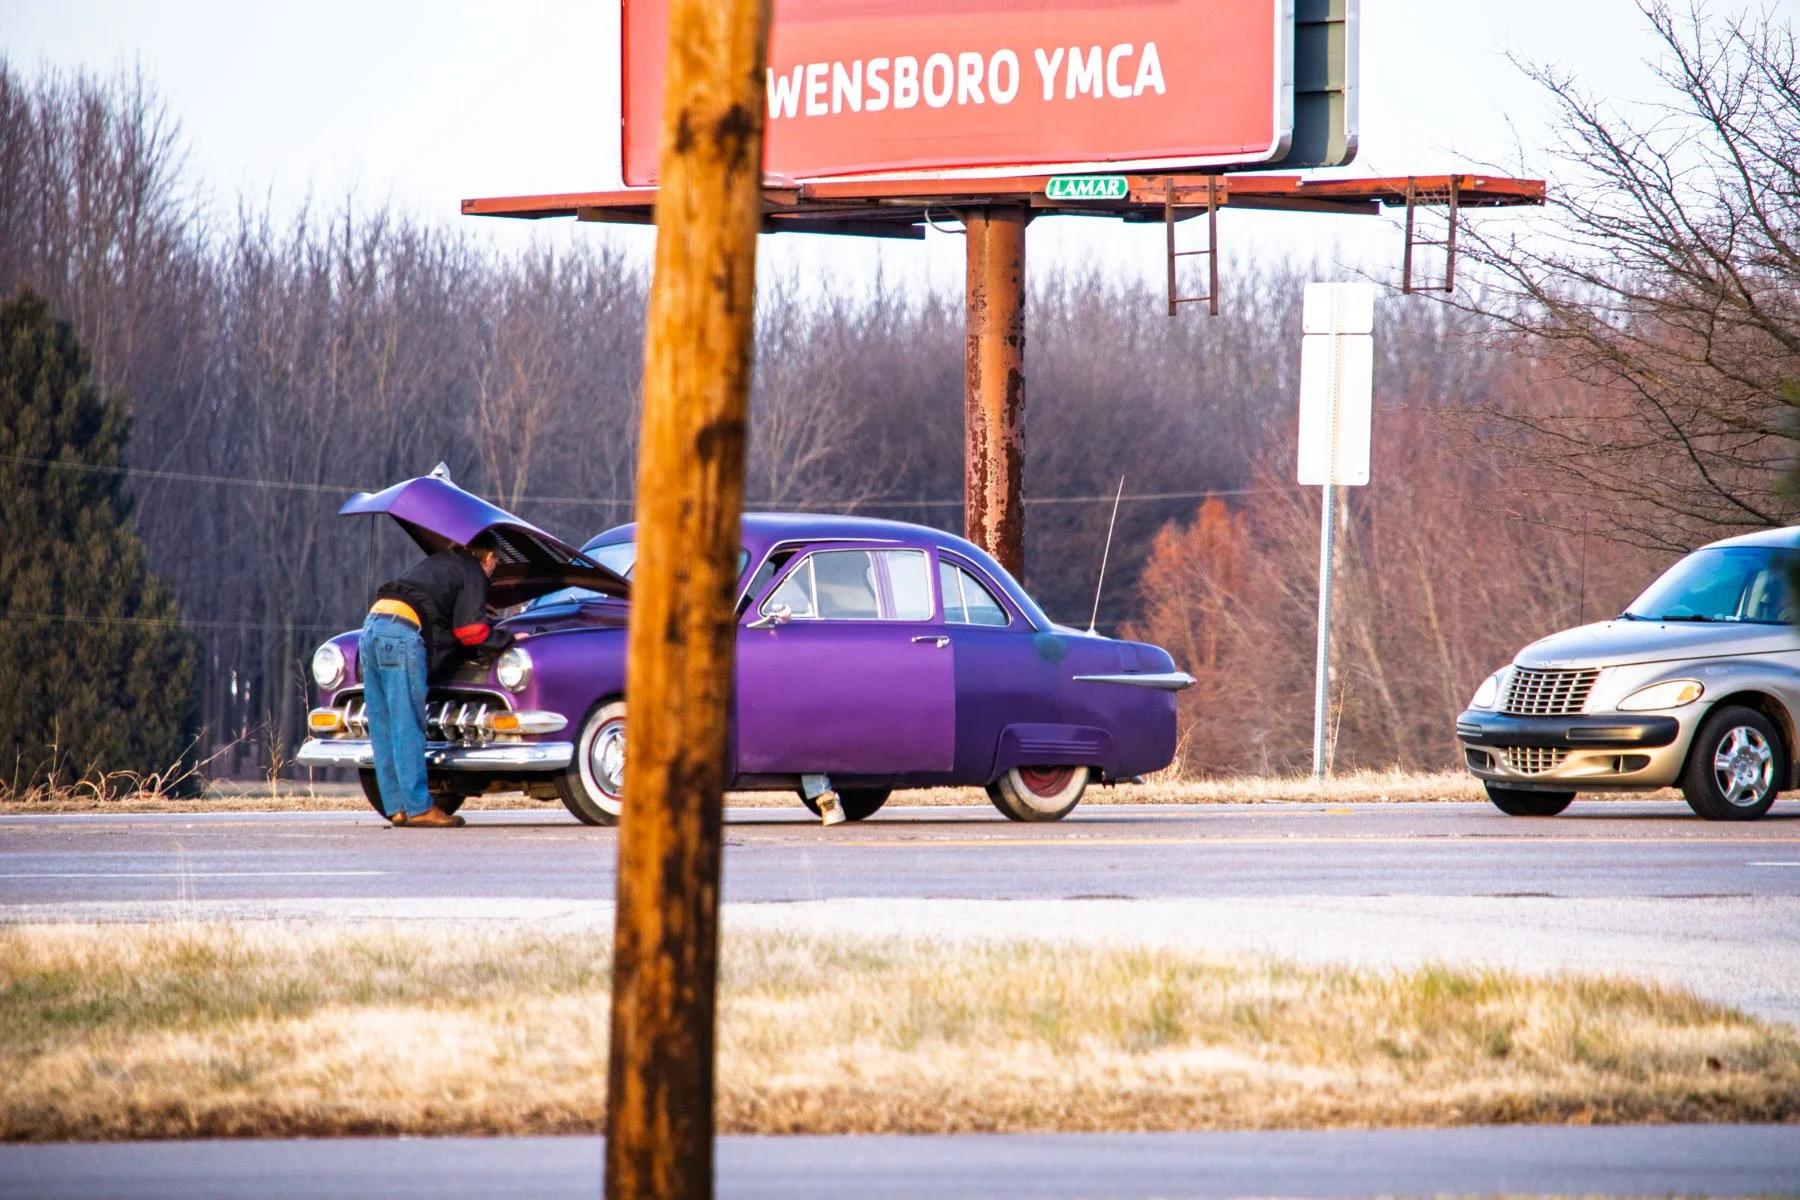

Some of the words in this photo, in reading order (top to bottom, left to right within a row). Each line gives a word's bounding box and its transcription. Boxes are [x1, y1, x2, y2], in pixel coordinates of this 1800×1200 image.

[765, 48, 1020, 119] WENSBORO
[1033, 41, 1167, 101] YMCA
[1052, 179, 1120, 196] LAMAR
